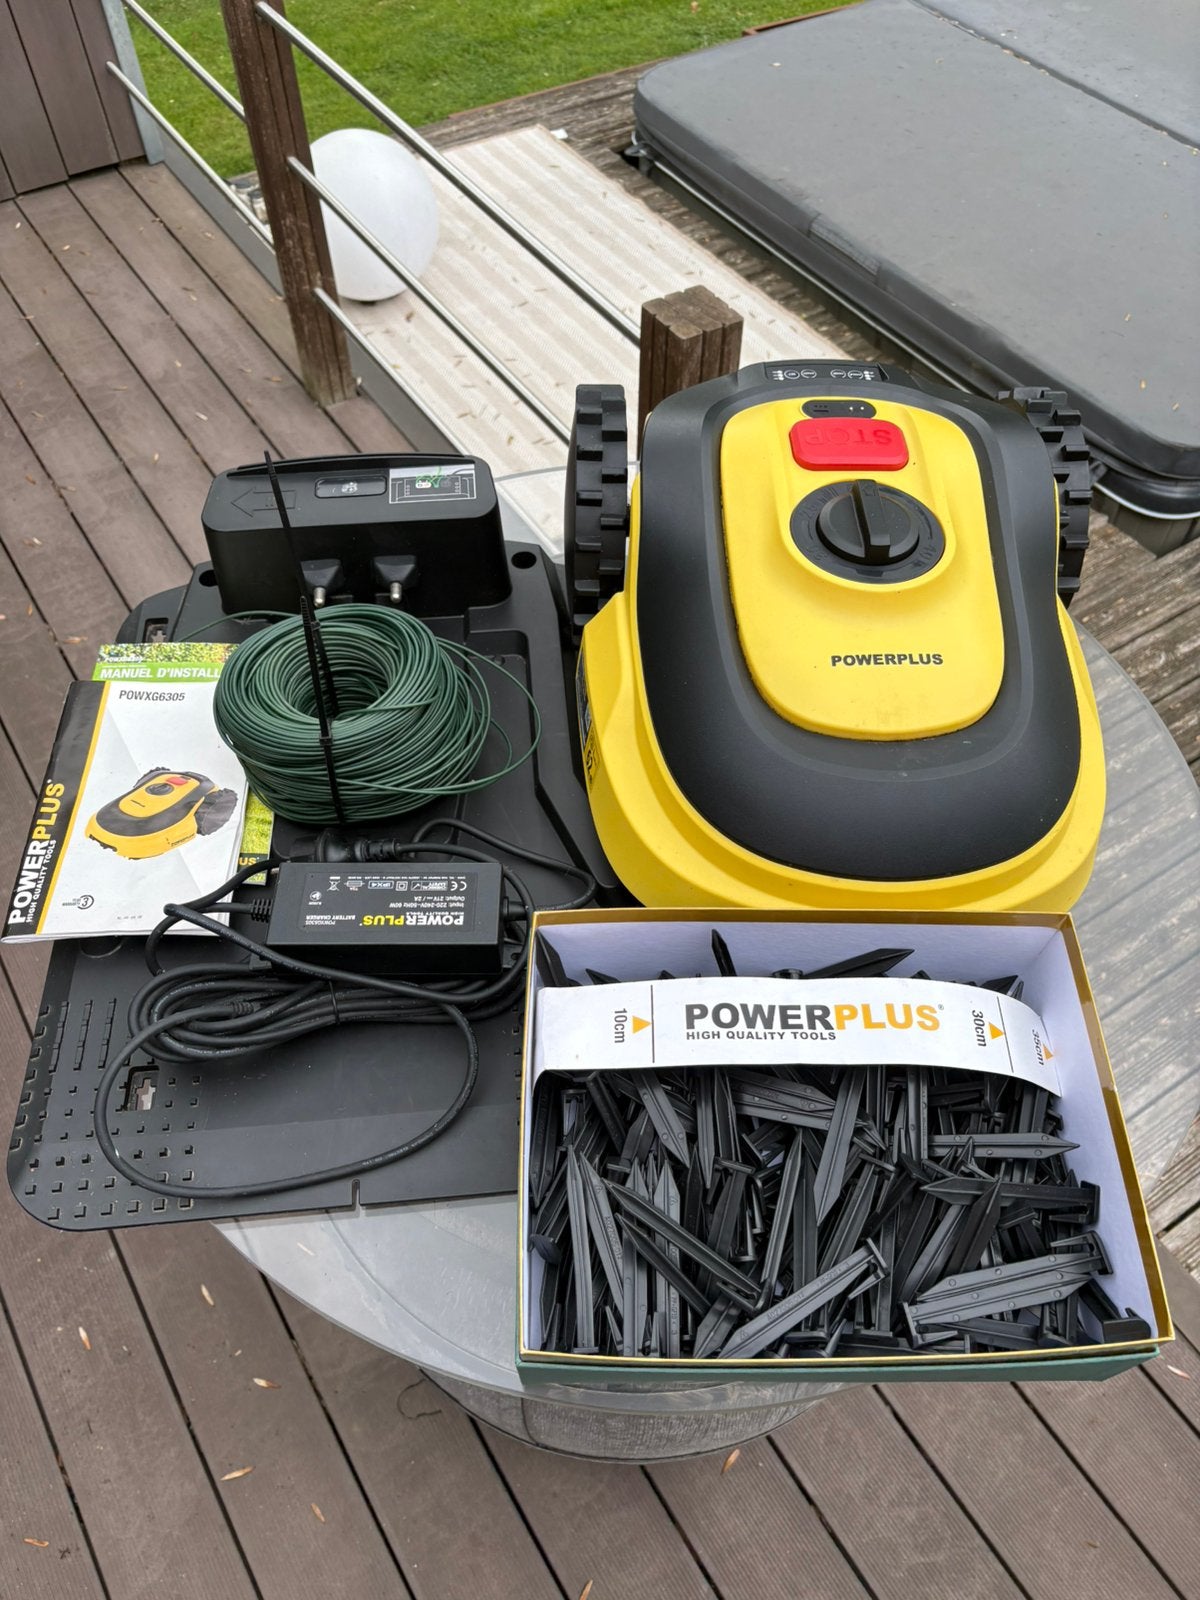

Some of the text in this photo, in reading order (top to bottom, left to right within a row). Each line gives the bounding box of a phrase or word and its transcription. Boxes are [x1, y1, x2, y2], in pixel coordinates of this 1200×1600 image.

[804, 428, 893, 446] STOP
[831, 653, 943, 666] POWERPLUS
[100, 668, 153, 679] MANUEL
[119, 690, 185, 702] POWXG6305
[8, 782, 65, 925] POWERPLUS
[25, 840, 57, 923] HIGH QUALITY TOOLS
[362, 914, 465, 927] POWERPLUS
[614, 1008, 628, 1044] 10cm
[971, 1009, 988, 1048] 30cm
[686, 1030, 837, 1041] HIGH QUALITY TOOLS
[1031, 1028, 1045, 1067] 35cm
